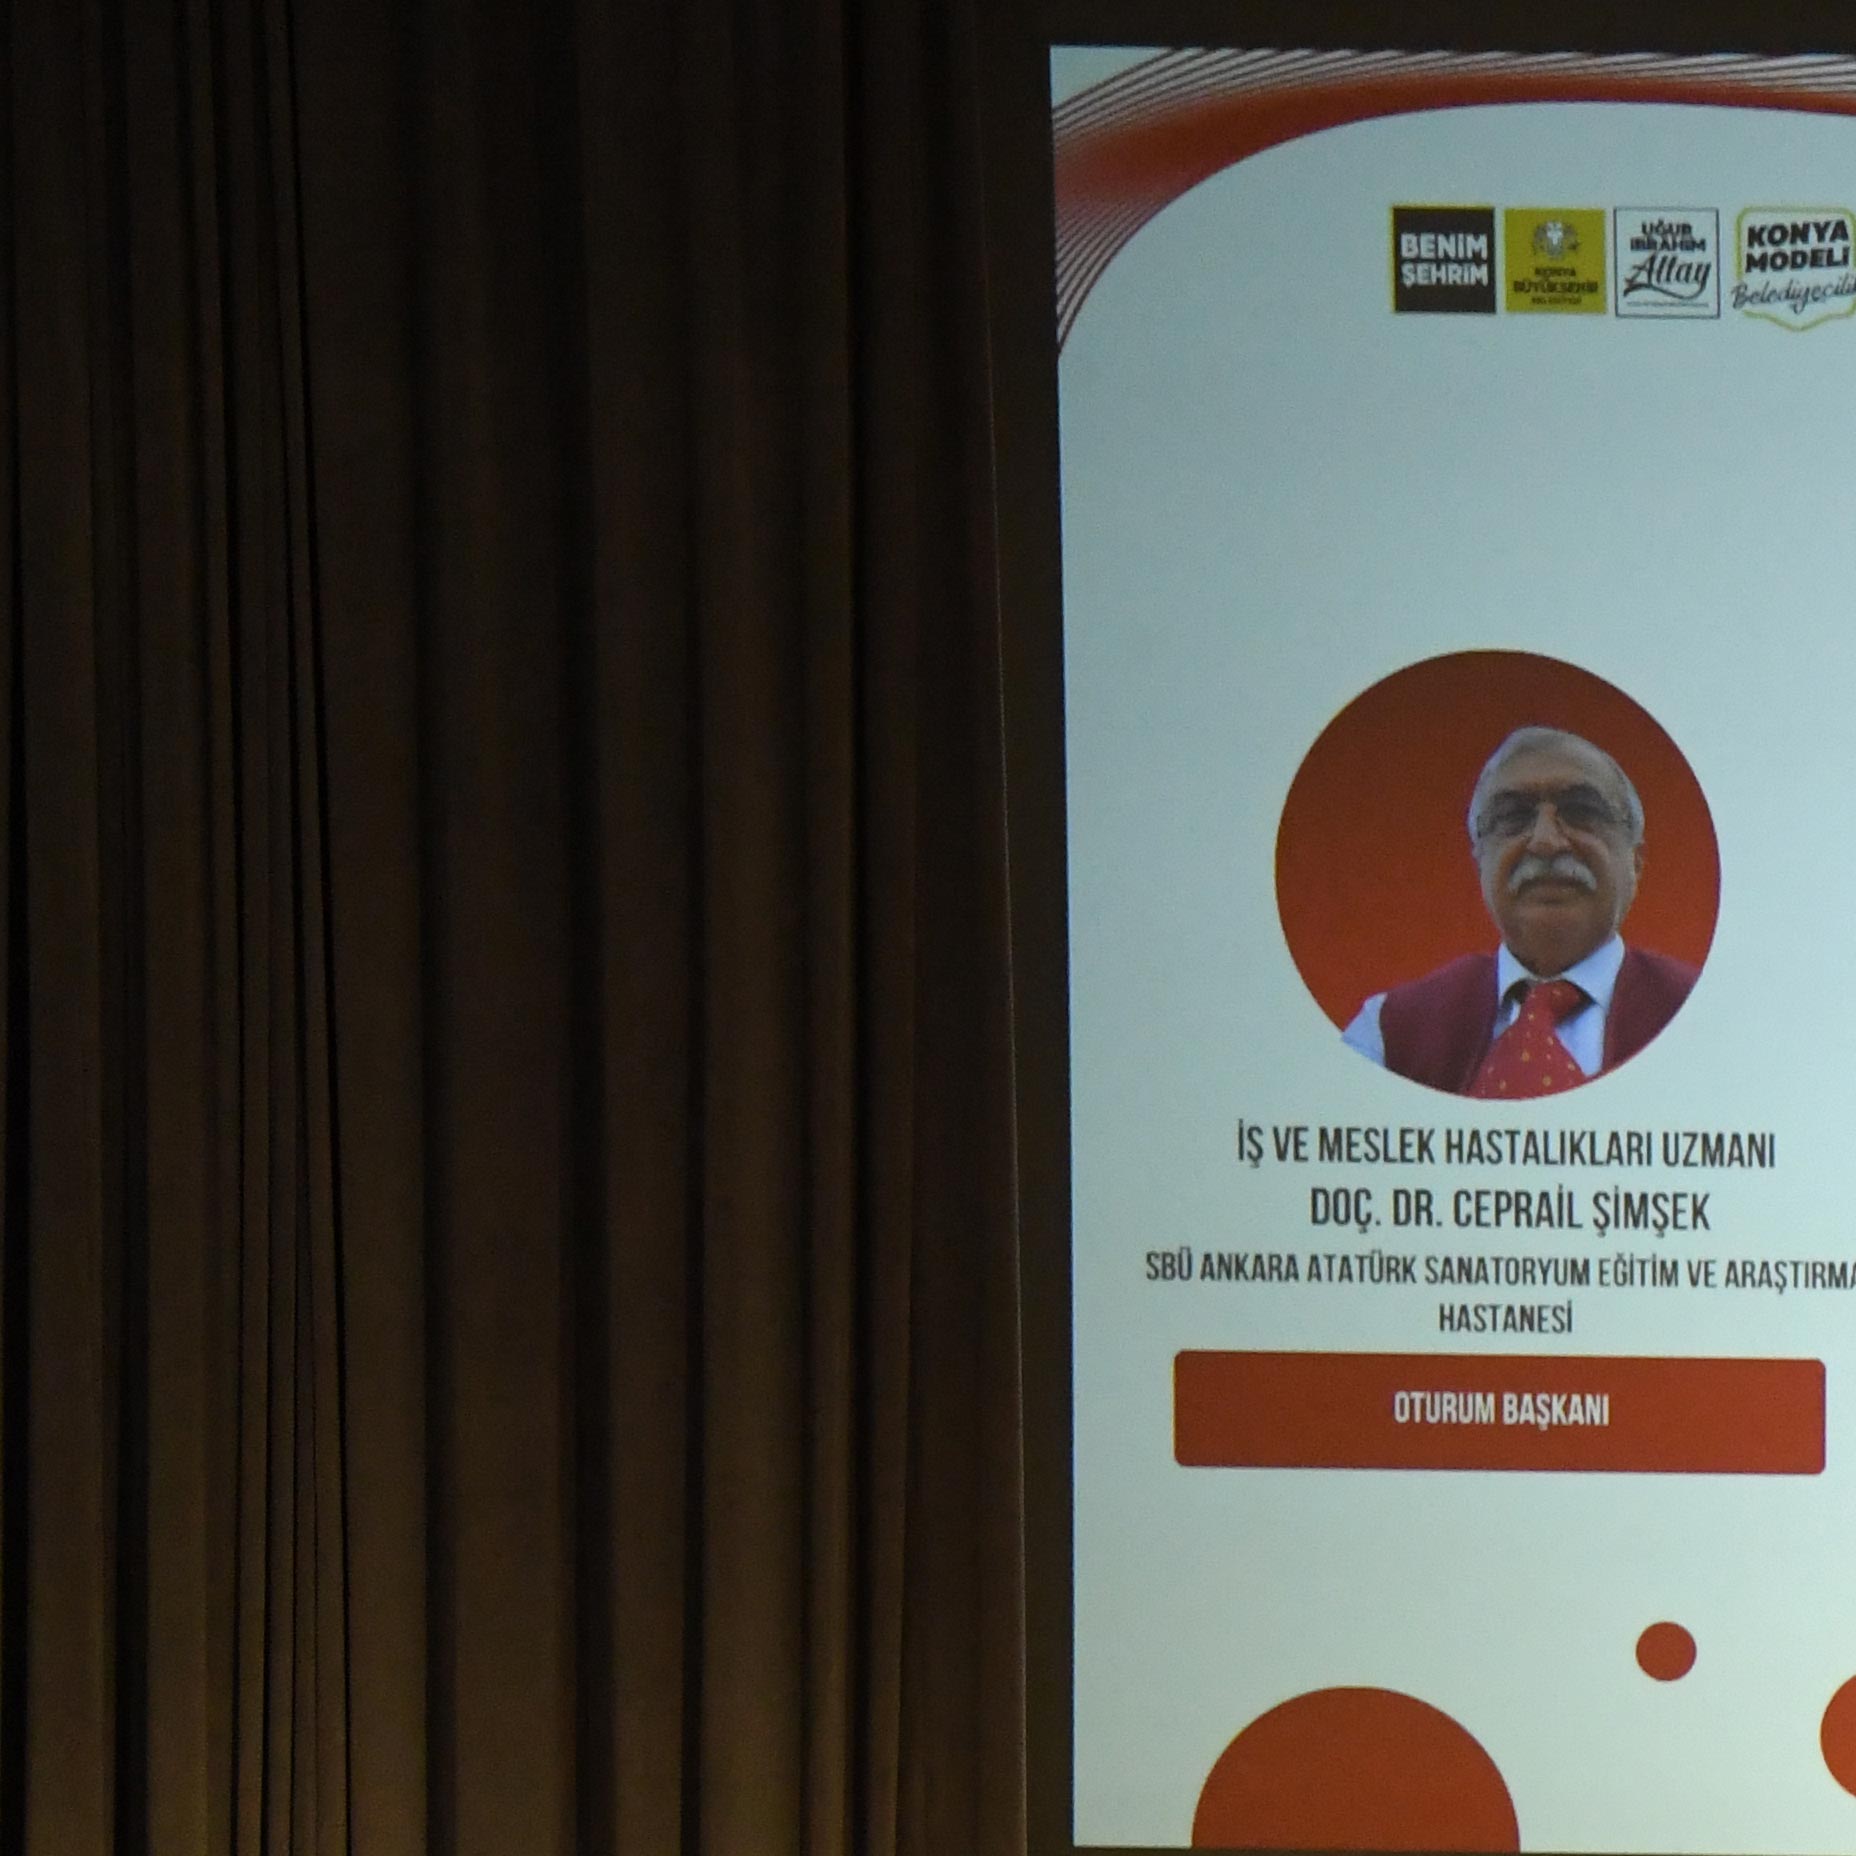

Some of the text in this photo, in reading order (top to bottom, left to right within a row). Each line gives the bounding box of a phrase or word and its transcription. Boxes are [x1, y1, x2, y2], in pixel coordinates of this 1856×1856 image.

[1400, 232, 1488, 260] BENİM
[1747, 219, 1849, 248] KONYA
[1401, 262, 1489, 288] ŞEHRİM
[1623, 253, 1712, 300] Altay
[1238, 1118, 1775, 1169] İŞ VE MESLEK HASTALIKLARI UZMANI
[1311, 1183, 1710, 1239] DOÇ. DR. CEPRAİL ŞİMŞEK
[1146, 1246, 1193, 1282] SBÜ
[1200, 1251, 1300, 1283] ANKARA
[1307, 1249, 1417, 1285] ATATÜRK
[1425, 1255, 1591, 1287] SANATORYUM
[1598, 1252, 1679, 1288] EĞİTİM
[1687, 1259, 1716, 1289] VE
[1439, 1300, 1573, 1334] HASTANESİ
[1394, 1390, 1610, 1431] OTURUM BAŞKANI
